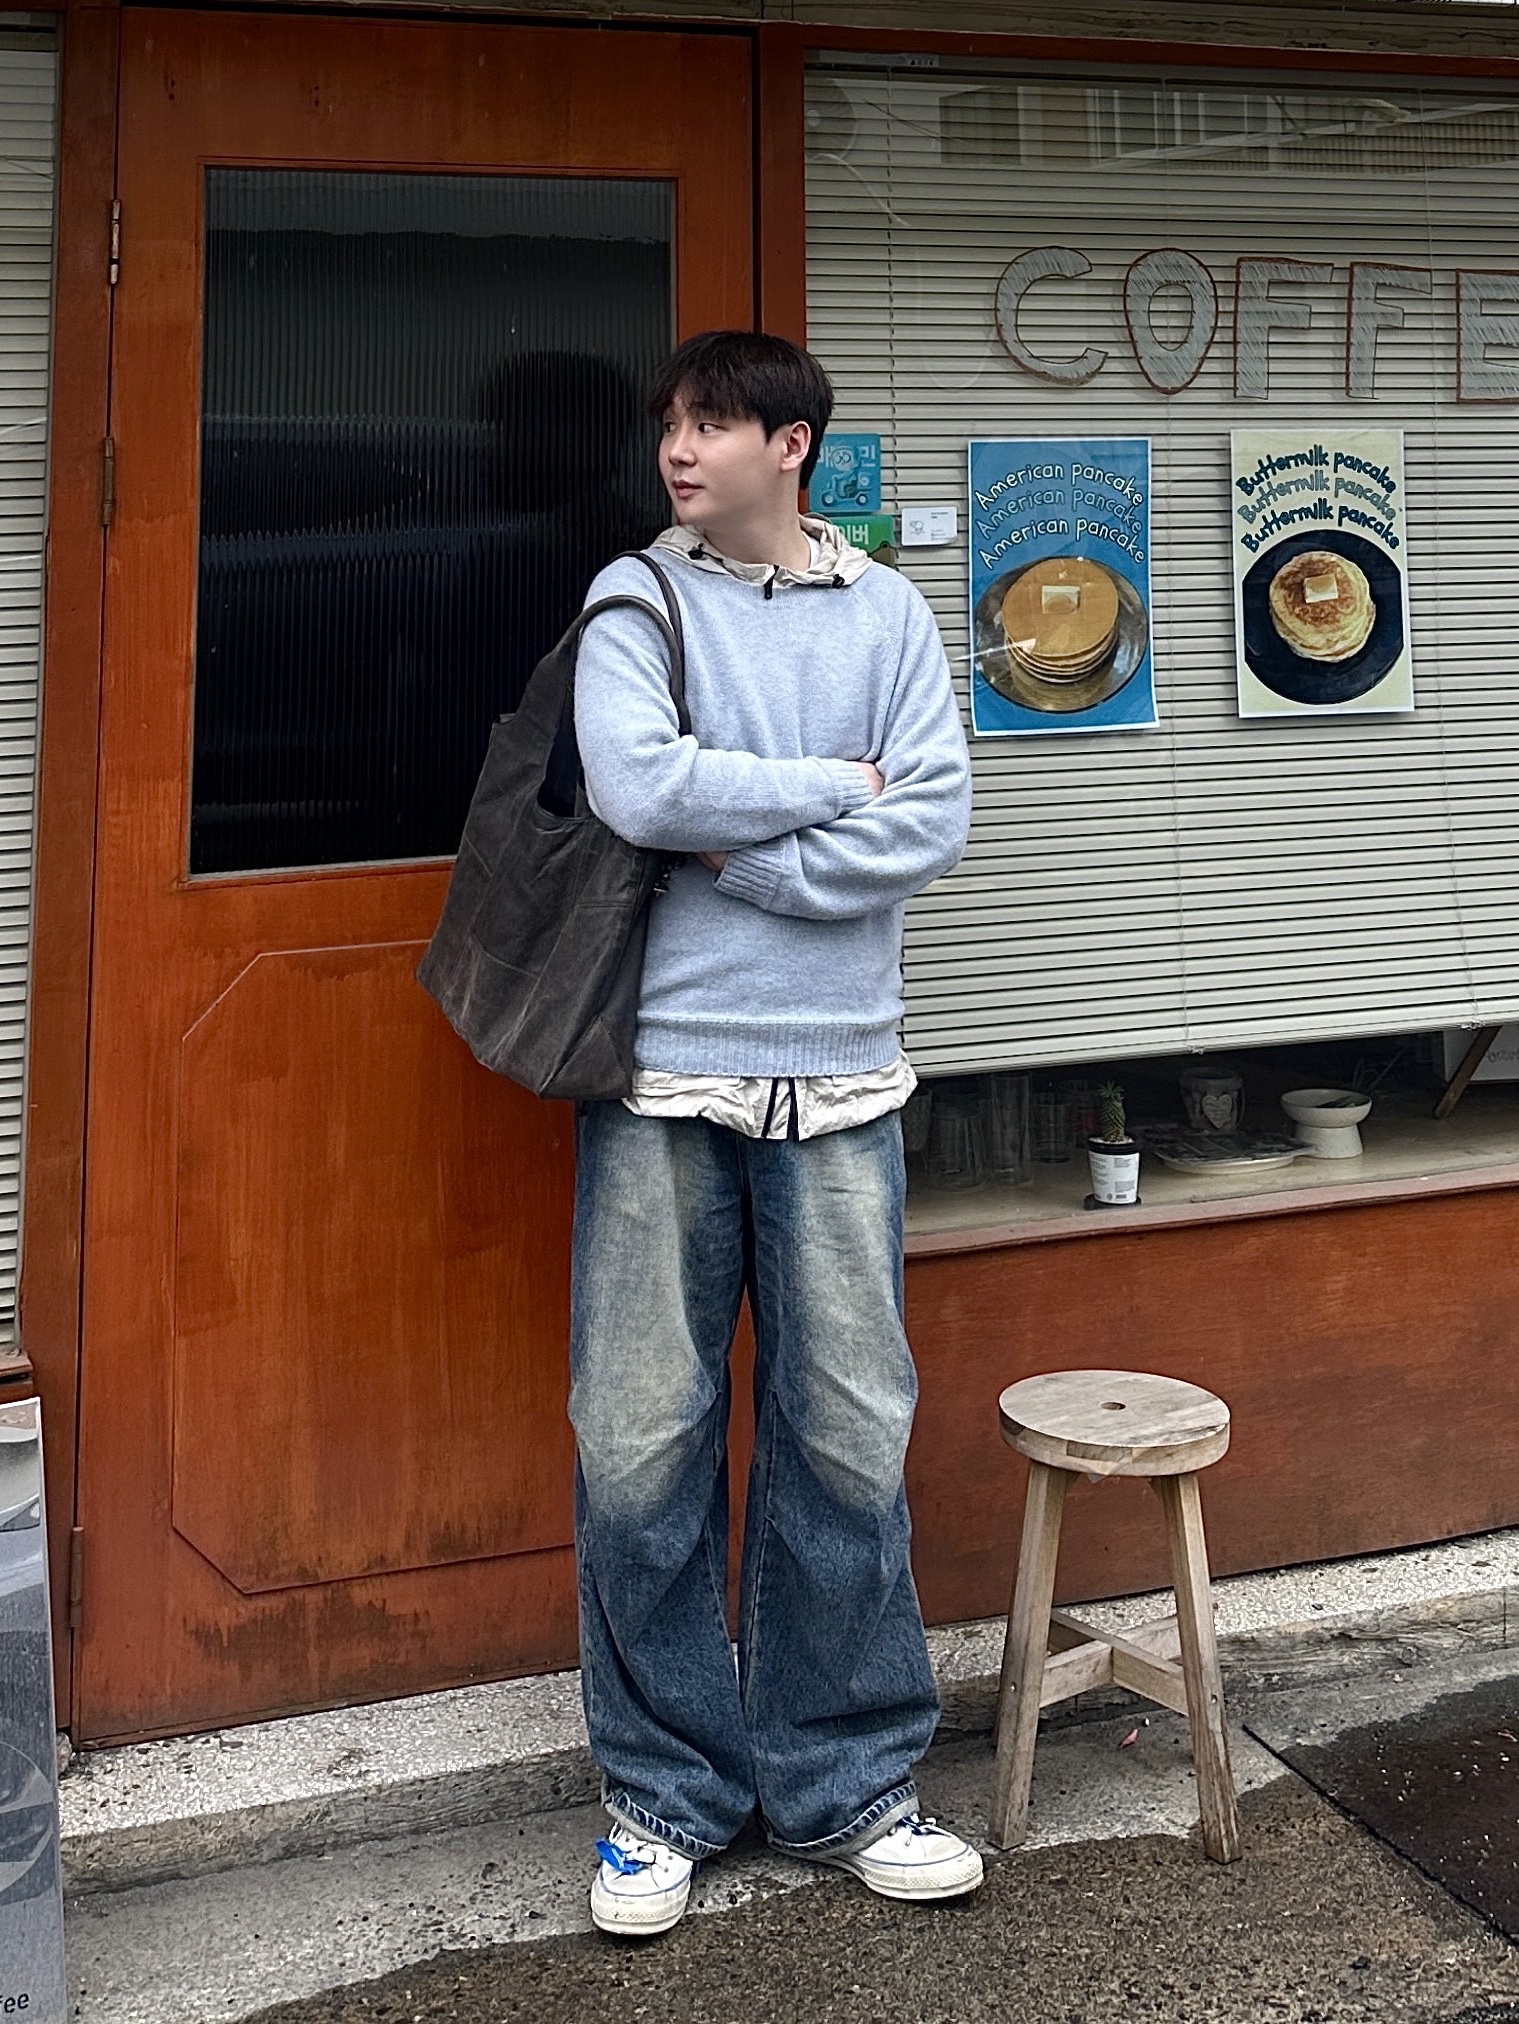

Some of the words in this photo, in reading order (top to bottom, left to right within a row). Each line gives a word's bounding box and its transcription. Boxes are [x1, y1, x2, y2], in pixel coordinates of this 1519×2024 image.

[995, 246, 1519, 403] COFFE
[974, 464, 1064, 511] American
[1071, 462, 1143, 506] pancake
[1235, 444, 1330, 496] Buttermilk
[1333, 452, 1396, 493] pancake
[975, 489, 1065, 540] American
[1072, 488, 1143, 534] pancake
[1237, 469, 1331, 524] Buttermilk
[1334, 477, 1396, 521] pancake
[979, 518, 1069, 570] American
[1076, 518, 1145, 564] pancake
[1240, 497, 1334, 553] Buttermilk
[1337, 505, 1400, 550] pancake
